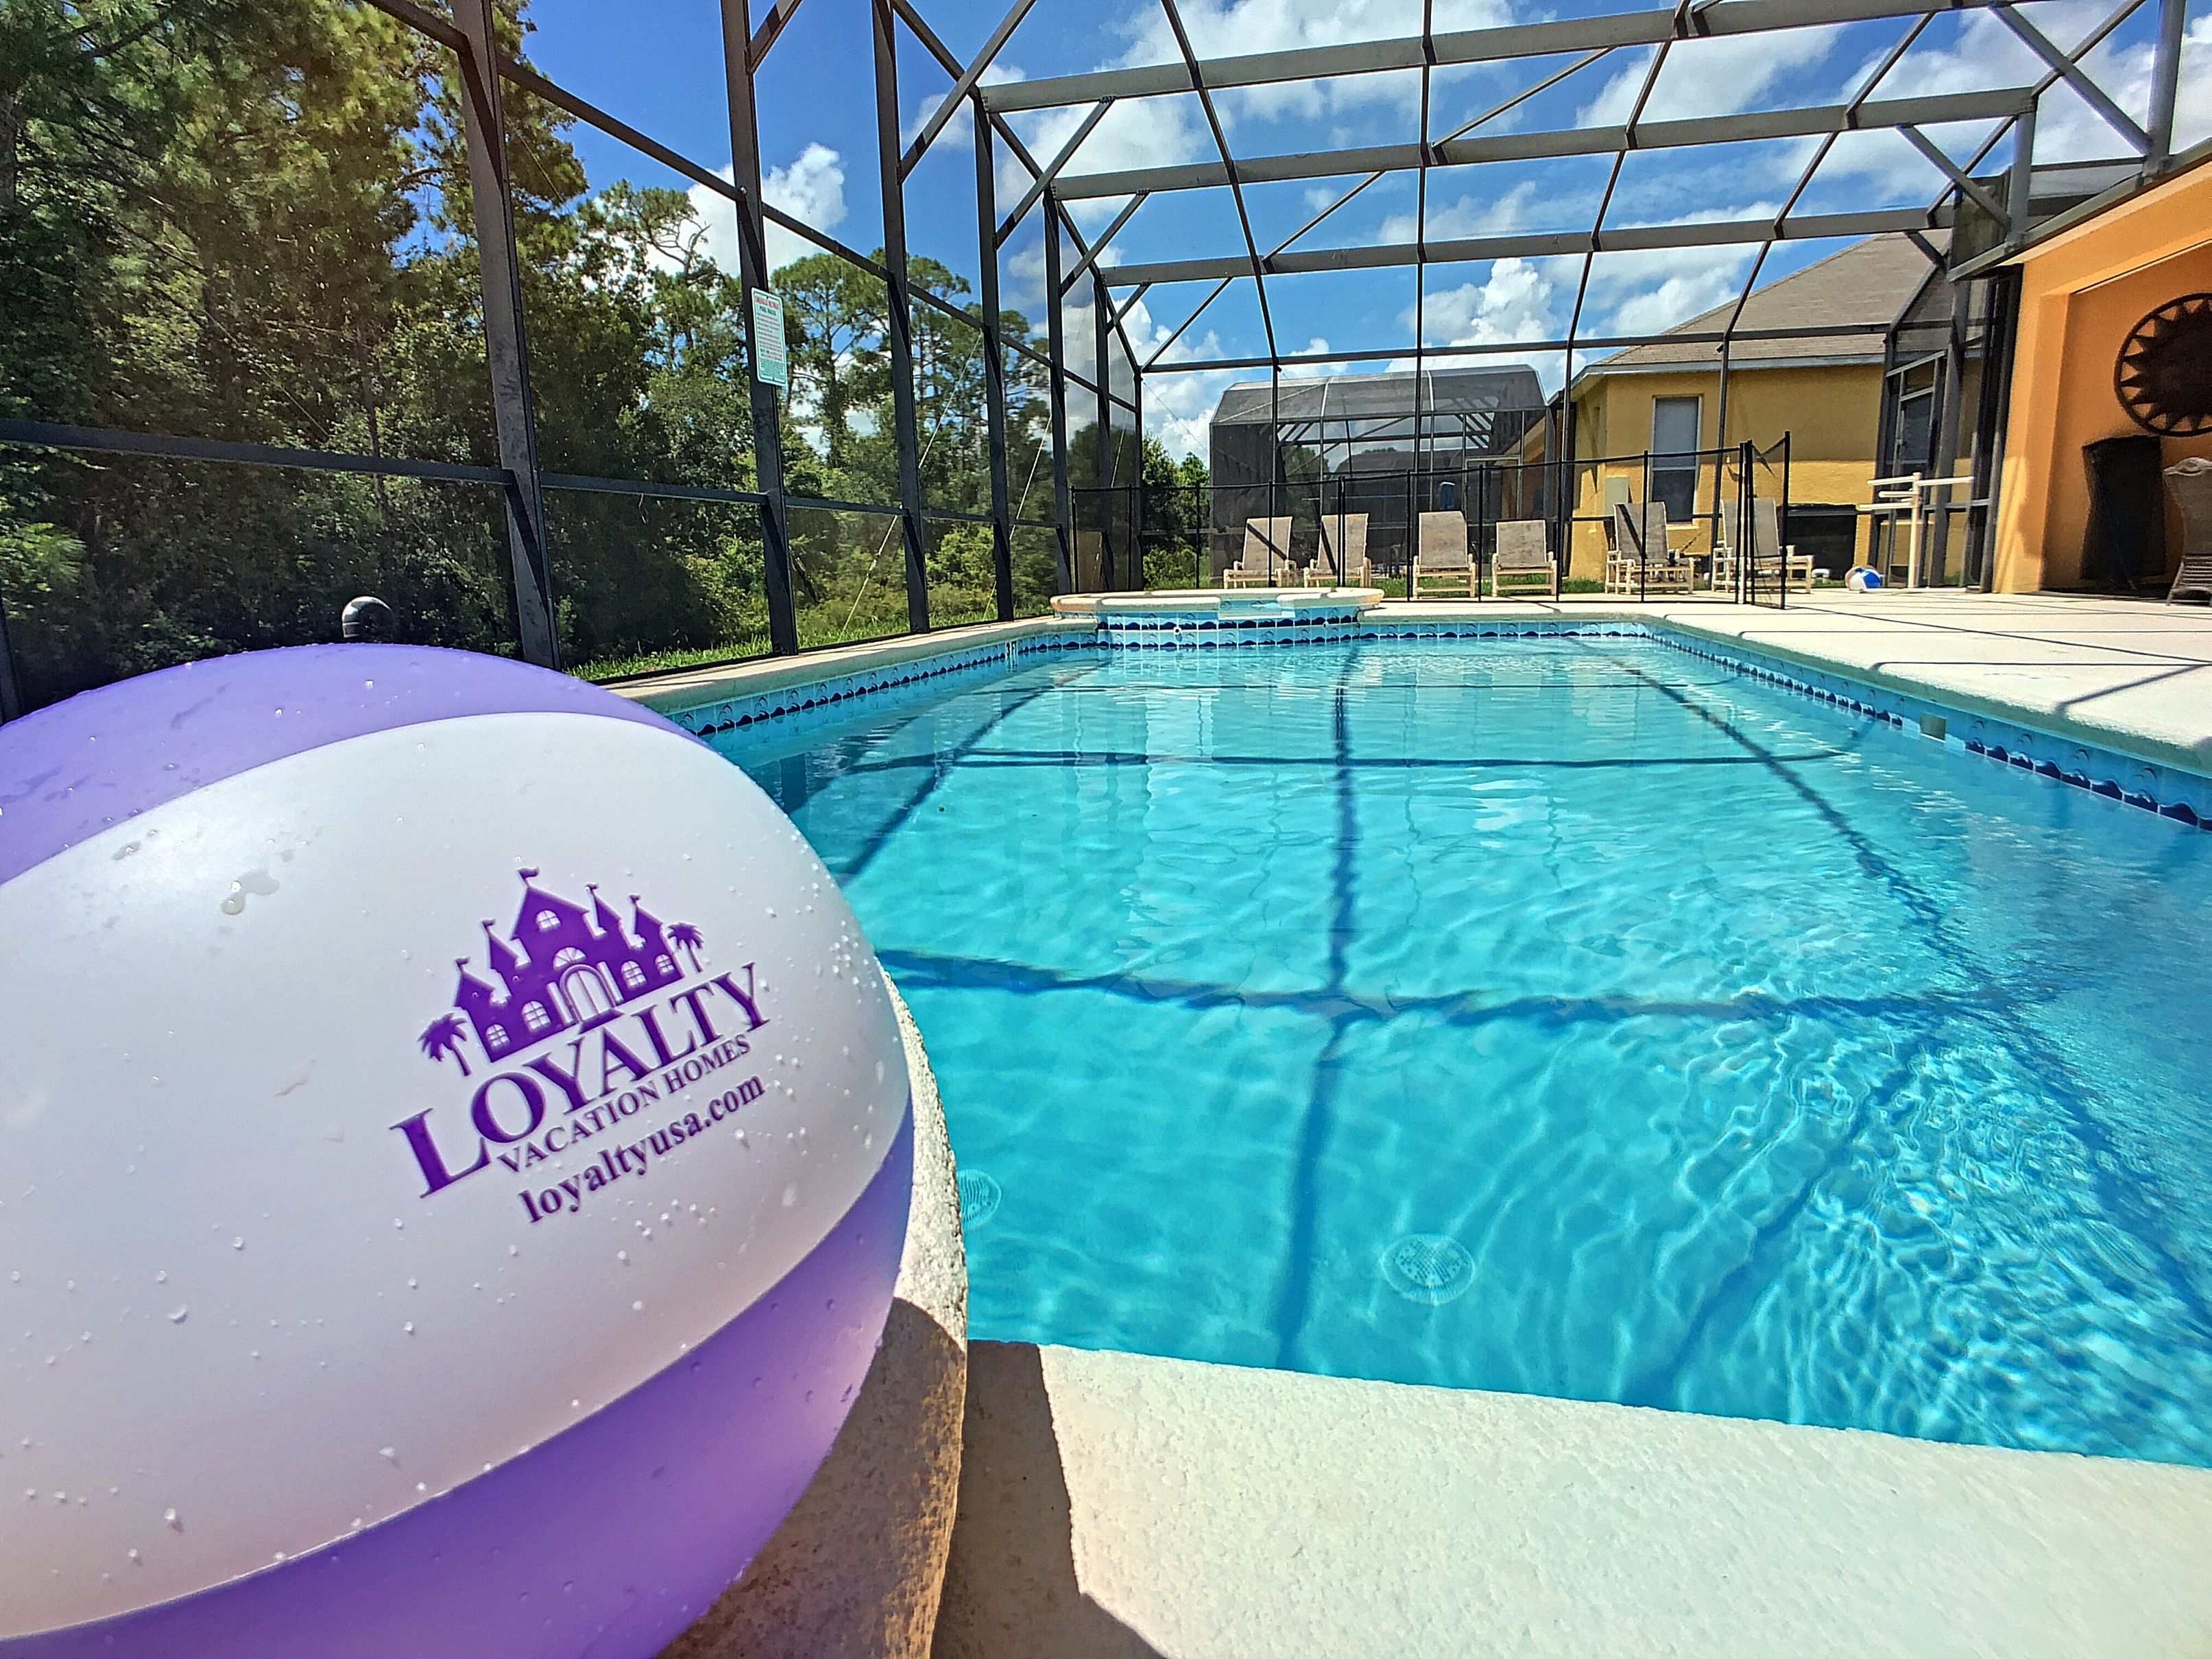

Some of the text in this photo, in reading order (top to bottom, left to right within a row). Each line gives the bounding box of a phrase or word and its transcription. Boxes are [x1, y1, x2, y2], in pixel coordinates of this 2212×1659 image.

[389, 962, 770, 1198] LOYALTY
[498, 1033, 752, 1173] VACATION HOMES
[518, 1075, 765, 1224] loyaltyusa.com
